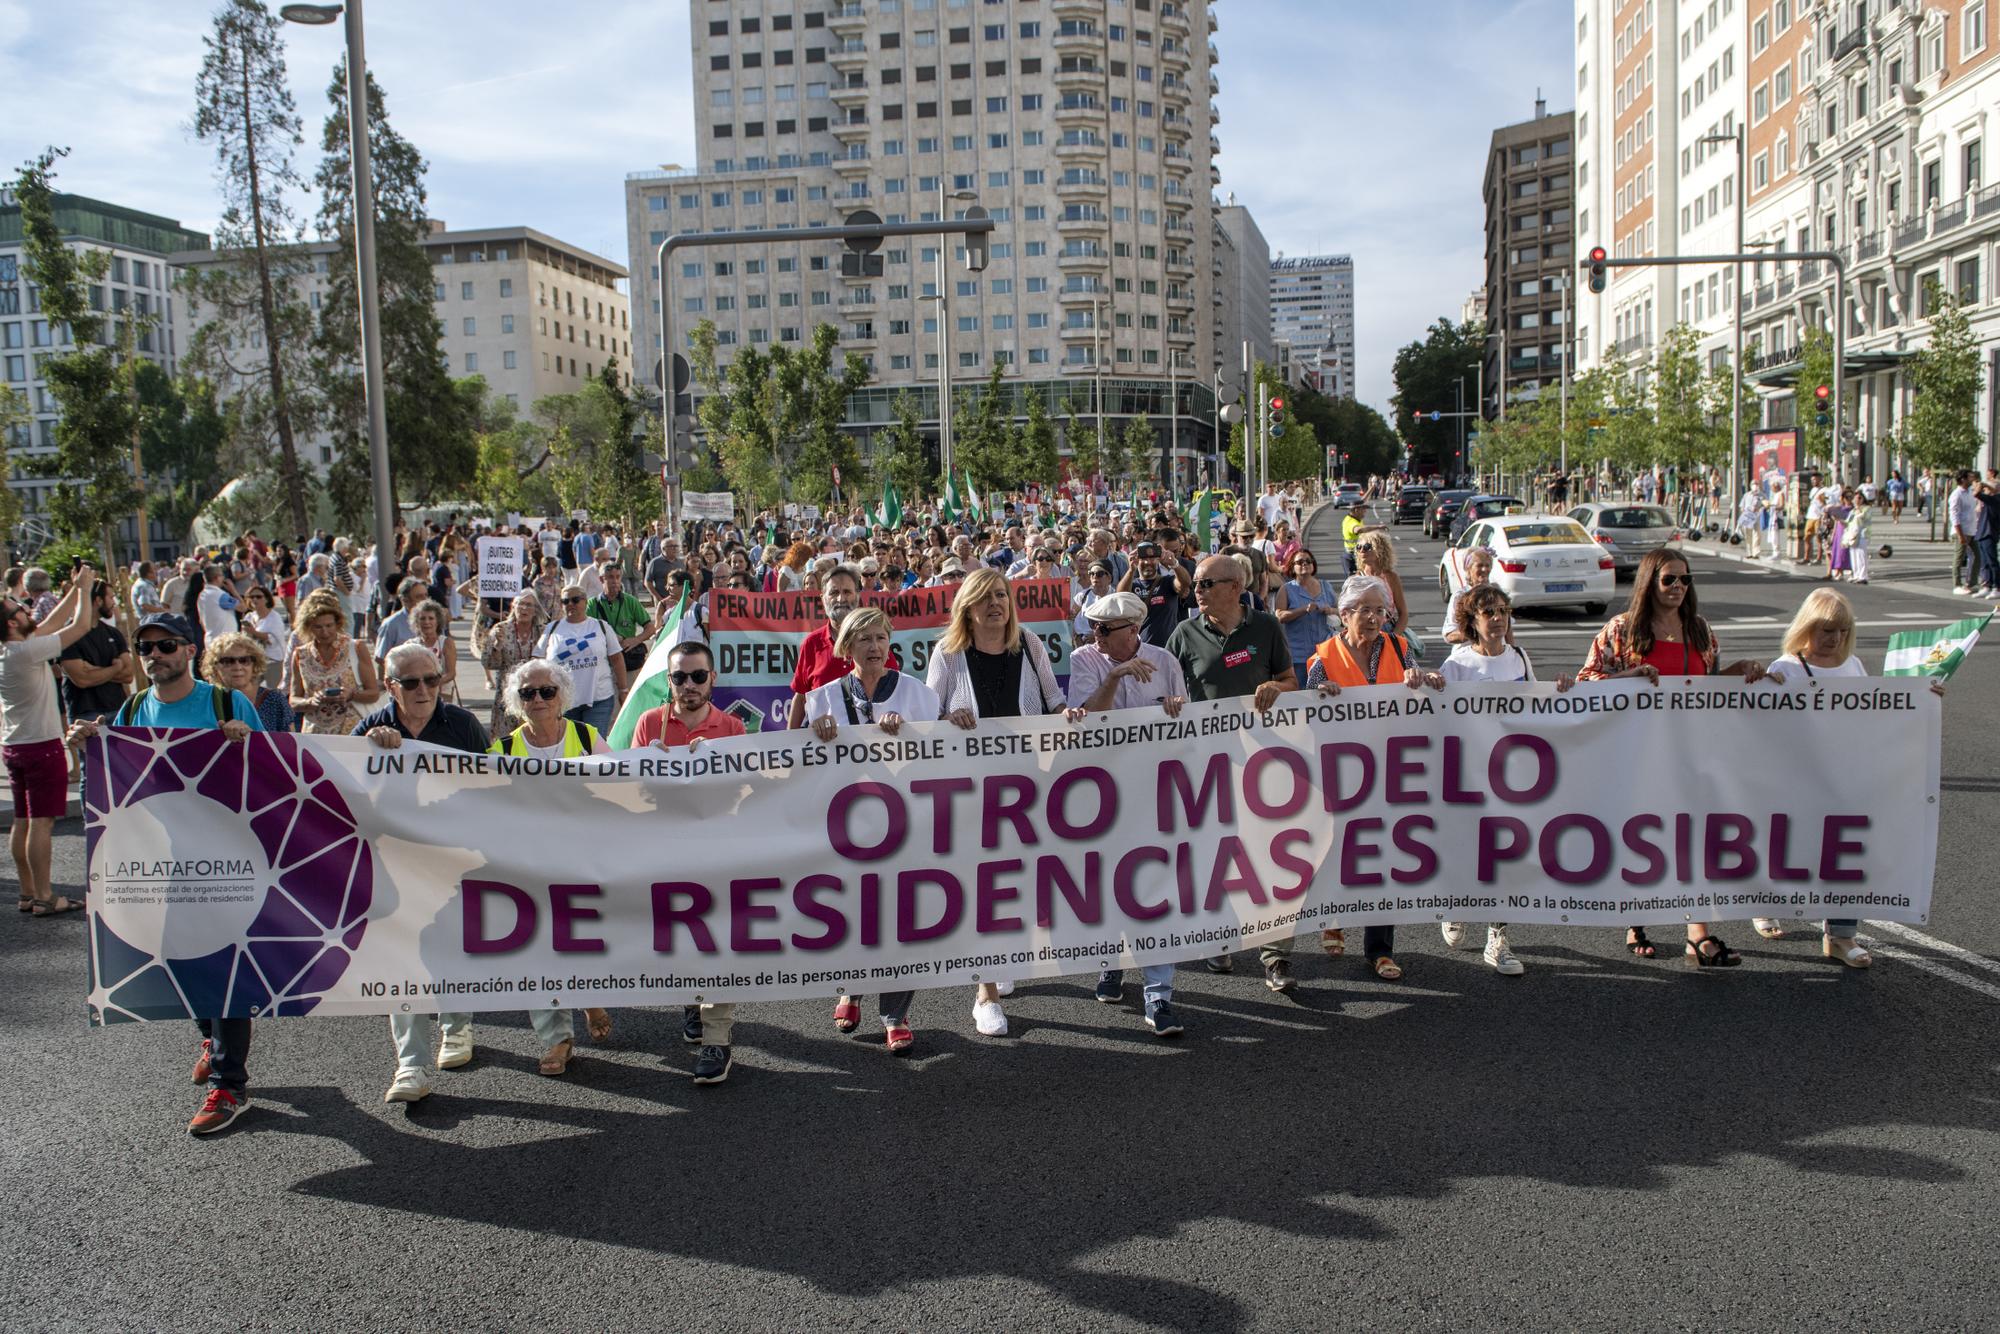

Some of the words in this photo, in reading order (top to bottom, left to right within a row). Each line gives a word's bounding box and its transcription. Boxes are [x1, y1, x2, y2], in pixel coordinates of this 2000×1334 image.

[1271, 258, 1296, 270] drid
[1300, 256, 1350, 268] Princesa
[487, 563, 513, 574] DEVORAN
[481, 580, 518, 592] RESIDENCIAS!
[717, 594, 748, 619] PER
[754, 597, 788, 621] UNA
[926, 592, 937, 615] A
[1017, 585, 1063, 609] GRAN
[571, 662, 598, 671] DENCIAS
[720, 644, 799, 673] DEFEN
[367, 754, 404, 775] UN
[413, 754, 488, 775] ALTRE
[497, 758, 591, 777] MODEL
[599, 760, 631, 777] DE
[639, 749, 794, 777] RESIDÈNCIES
[802, 737, 828, 767] ÉS
[836, 739, 945, 765] POSSIBLE
[966, 734, 1032, 757] BESTE
[1040, 720, 1197, 752] ERRESIDENTZIA
[1201, 711, 1254, 737] EREDU
[1262, 707, 1298, 728] BAT
[1306, 700, 1400, 724] POSIBLEA
[1406, 697, 1434, 715] DA
[1454, 696, 1524, 715] OUTRO
[1531, 693, 1629, 714] MODELO
[1637, 692, 1663, 710] DE
[1671, 691, 1807, 711] RESIDENCIAS
[1813, 689, 1824, 711] É
[1830, 688, 1916, 710] POSÍBEL
[827, 765, 1119, 861] OTRO
[1156, 734, 1558, 833] MODELO
[105, 859, 255, 878] LAPLATAFORMA
[105, 886, 149, 894] Plataforma
[152, 885, 179, 894] estatal
[181, 885, 191, 893] de
[194, 884, 254, 895] organizaciones
[461, 879, 605, 955] DE
[650, 827, 1314, 953] RESIDENCIAS
[1340, 814, 1438, 886] ES
[1477, 812, 1870, 885] POSIBLE
[118, 896, 155, 904] familiares
[210, 895, 254, 903] residencias
[361, 982, 386, 997] NO
[391, 985, 399, 996] a
[404, 981, 418, 995] la
[422, 977, 513, 995] vulneración
[519, 977, 537, 992] de
[541, 976, 562, 991] los
[568, 974, 635, 990] derechos
[640, 973, 750, 988] fundamentales
[755, 971, 773, 986] de
[778, 970, 797, 984] las
[802, 967, 867, 987] personas
[871, 960, 930, 980] mayores
[934, 960, 942, 974] y
[946, 953, 1007, 972] personas
[1011, 950, 1035, 964] con
[1039, 940, 1125, 961] discapacidad
[1136, 936, 1156, 951] NO
[1159, 938, 1167, 949] a
[1171, 933, 1181, 947] la
[1184, 923, 1238, 944] violación
[1241, 923, 1255, 935] de
[1257, 918, 1271, 932] los
[1274, 908, 1318, 928] derechos
[1320, 901, 1375, 916] laborales
[1378, 898, 1393, 910] de
[1397, 897, 1413, 909] las
[1416, 895, 1497, 910] trabajadoras
[1508, 896, 1529, 908] NO
[1533, 899, 1541, 908] a
[1544, 896, 1556, 909] la
[1561, 896, 1616, 911] obscena
[1620, 895, 1694, 914] privatización
[1698, 893, 1710, 906] de
[1713, 892, 1729, 905] los
[1732, 891, 1787, 905] servicios
[1791, 891, 1805, 905] de
[1809, 891, 1820, 905] la
[1824, 891, 1910, 907] dependencia
